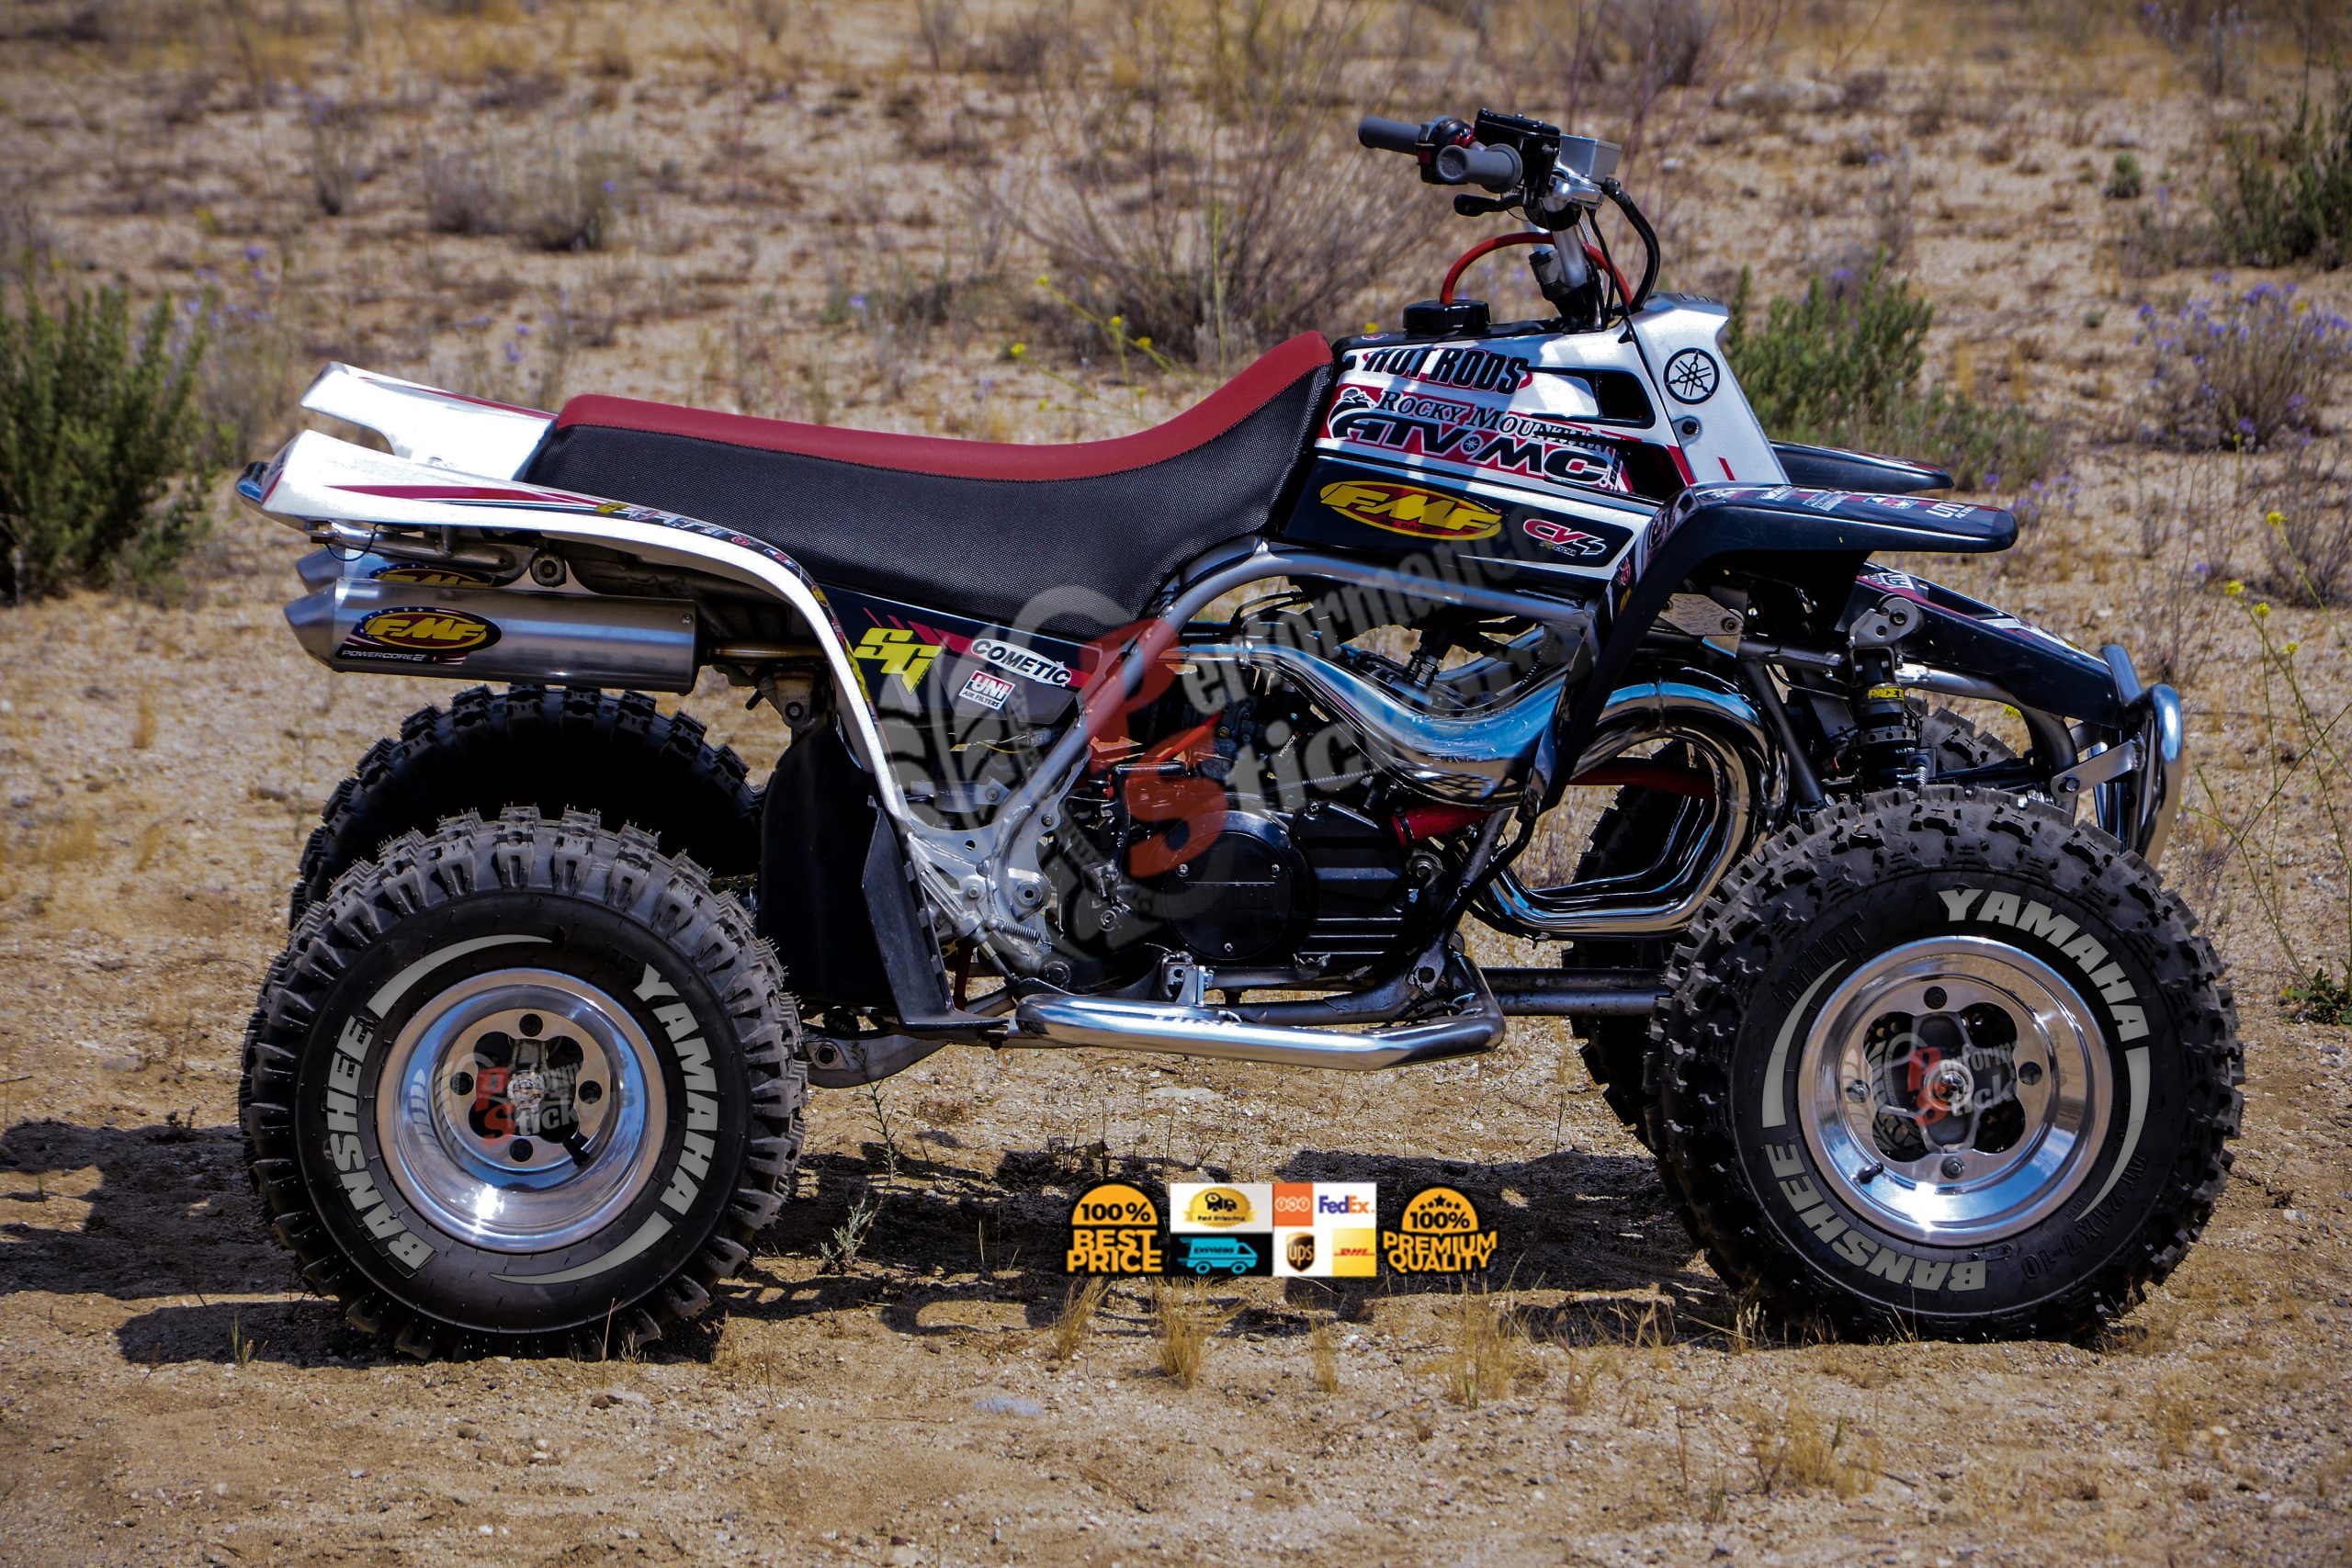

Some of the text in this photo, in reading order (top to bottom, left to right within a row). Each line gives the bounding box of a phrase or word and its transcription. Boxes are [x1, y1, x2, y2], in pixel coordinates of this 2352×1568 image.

[1363, 347, 1529, 395] HOT RODS
[1320, 484, 1503, 532] FMF
[366, 617, 487, 641] FMF
[972, 639, 1071, 685] COMETIC
[962, 690, 1001, 707] AIR FILTERS
[971, 675, 1010, 700] UNI
[1937, 887, 2151, 1043] YAMAHA
[632, 963, 718, 1215] YAMAHA
[326, 1015, 438, 1275] BANSHEE
[1765, 1143, 1987, 1292] BANSHEE
